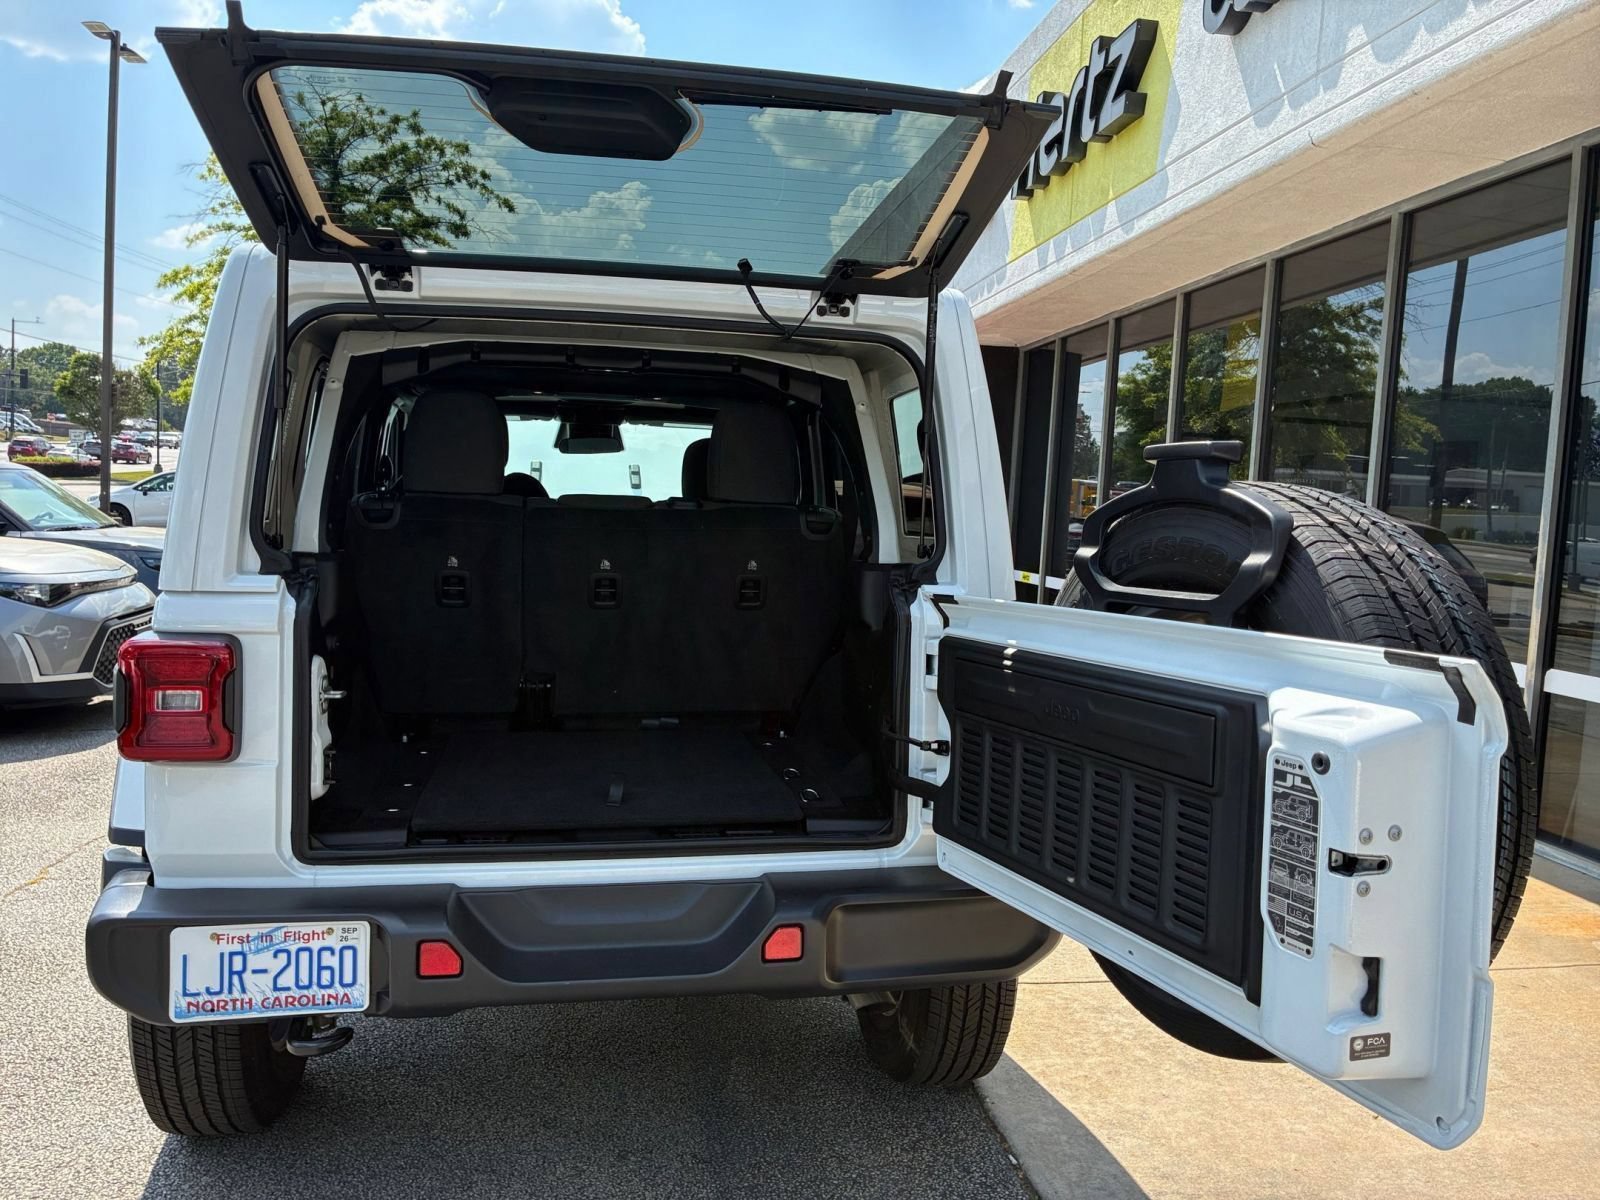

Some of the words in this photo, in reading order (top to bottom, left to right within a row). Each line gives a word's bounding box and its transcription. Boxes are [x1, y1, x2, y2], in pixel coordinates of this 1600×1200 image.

[1281, 760, 1297, 770] Jeep
[1274, 773, 1312, 790] JL
[215, 933, 250, 945] First
[260, 932, 273, 943] in
[284, 929, 327, 944] Flight
[182, 945, 357, 997] LJR-2060
[187, 997, 253, 1013] NORTH
[261, 992, 352, 1009] CAROLINA
[1367, 1037, 1385, 1045] FCA
